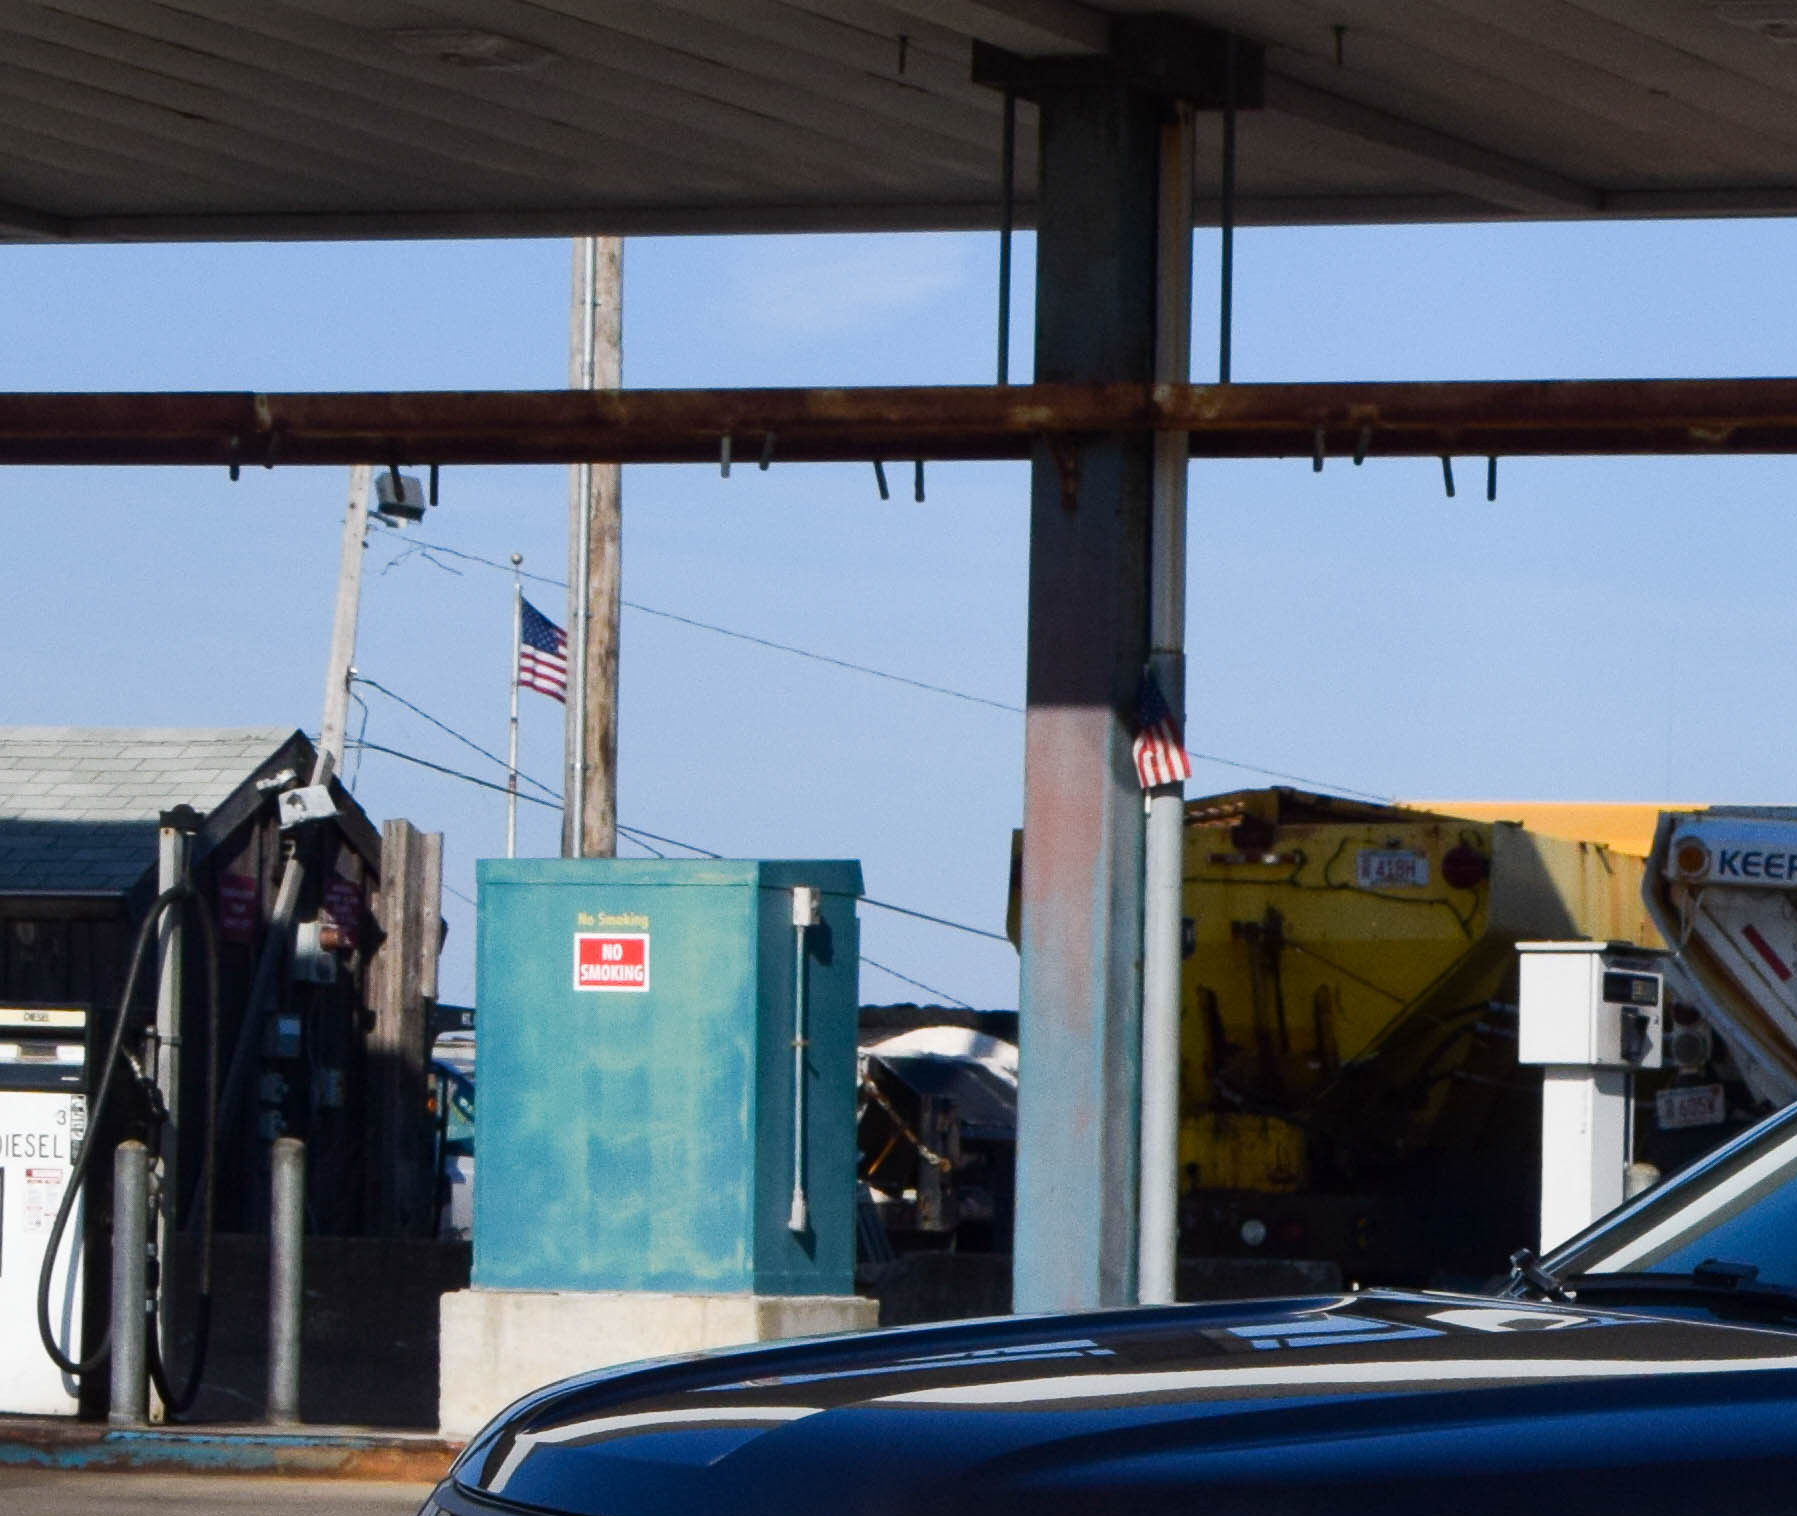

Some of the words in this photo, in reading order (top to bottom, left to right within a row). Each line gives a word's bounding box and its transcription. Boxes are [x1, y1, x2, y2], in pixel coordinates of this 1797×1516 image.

[577, 911, 594, 927] No
[598, 911, 649, 929] Smoking
[601, 943, 623, 961] NO
[580, 964, 644, 983] SMOKING
[56, 1110, 66, 1126] 3
[0, 1133, 65, 1159] IESEL
